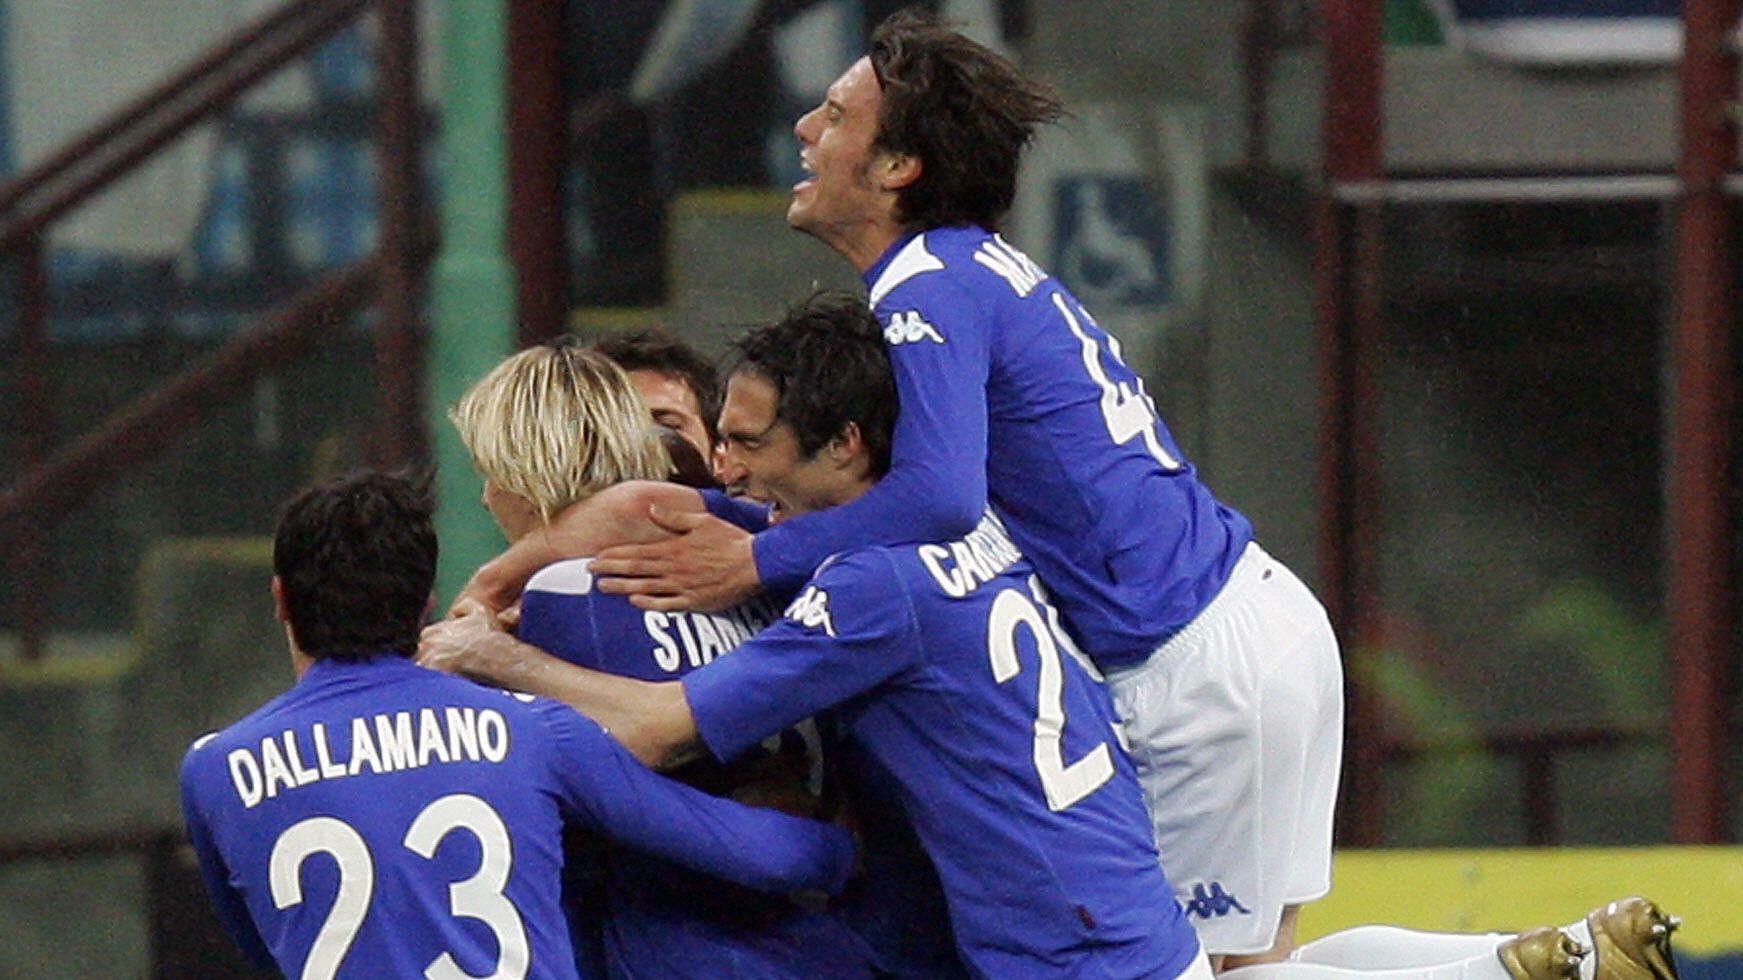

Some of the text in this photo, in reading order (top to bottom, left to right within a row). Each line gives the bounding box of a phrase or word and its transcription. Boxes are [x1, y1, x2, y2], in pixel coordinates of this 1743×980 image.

[227, 707, 509, 809] DALLAMANO
[988, 573, 1132, 812] 2
[268, 793, 531, 980] 23
